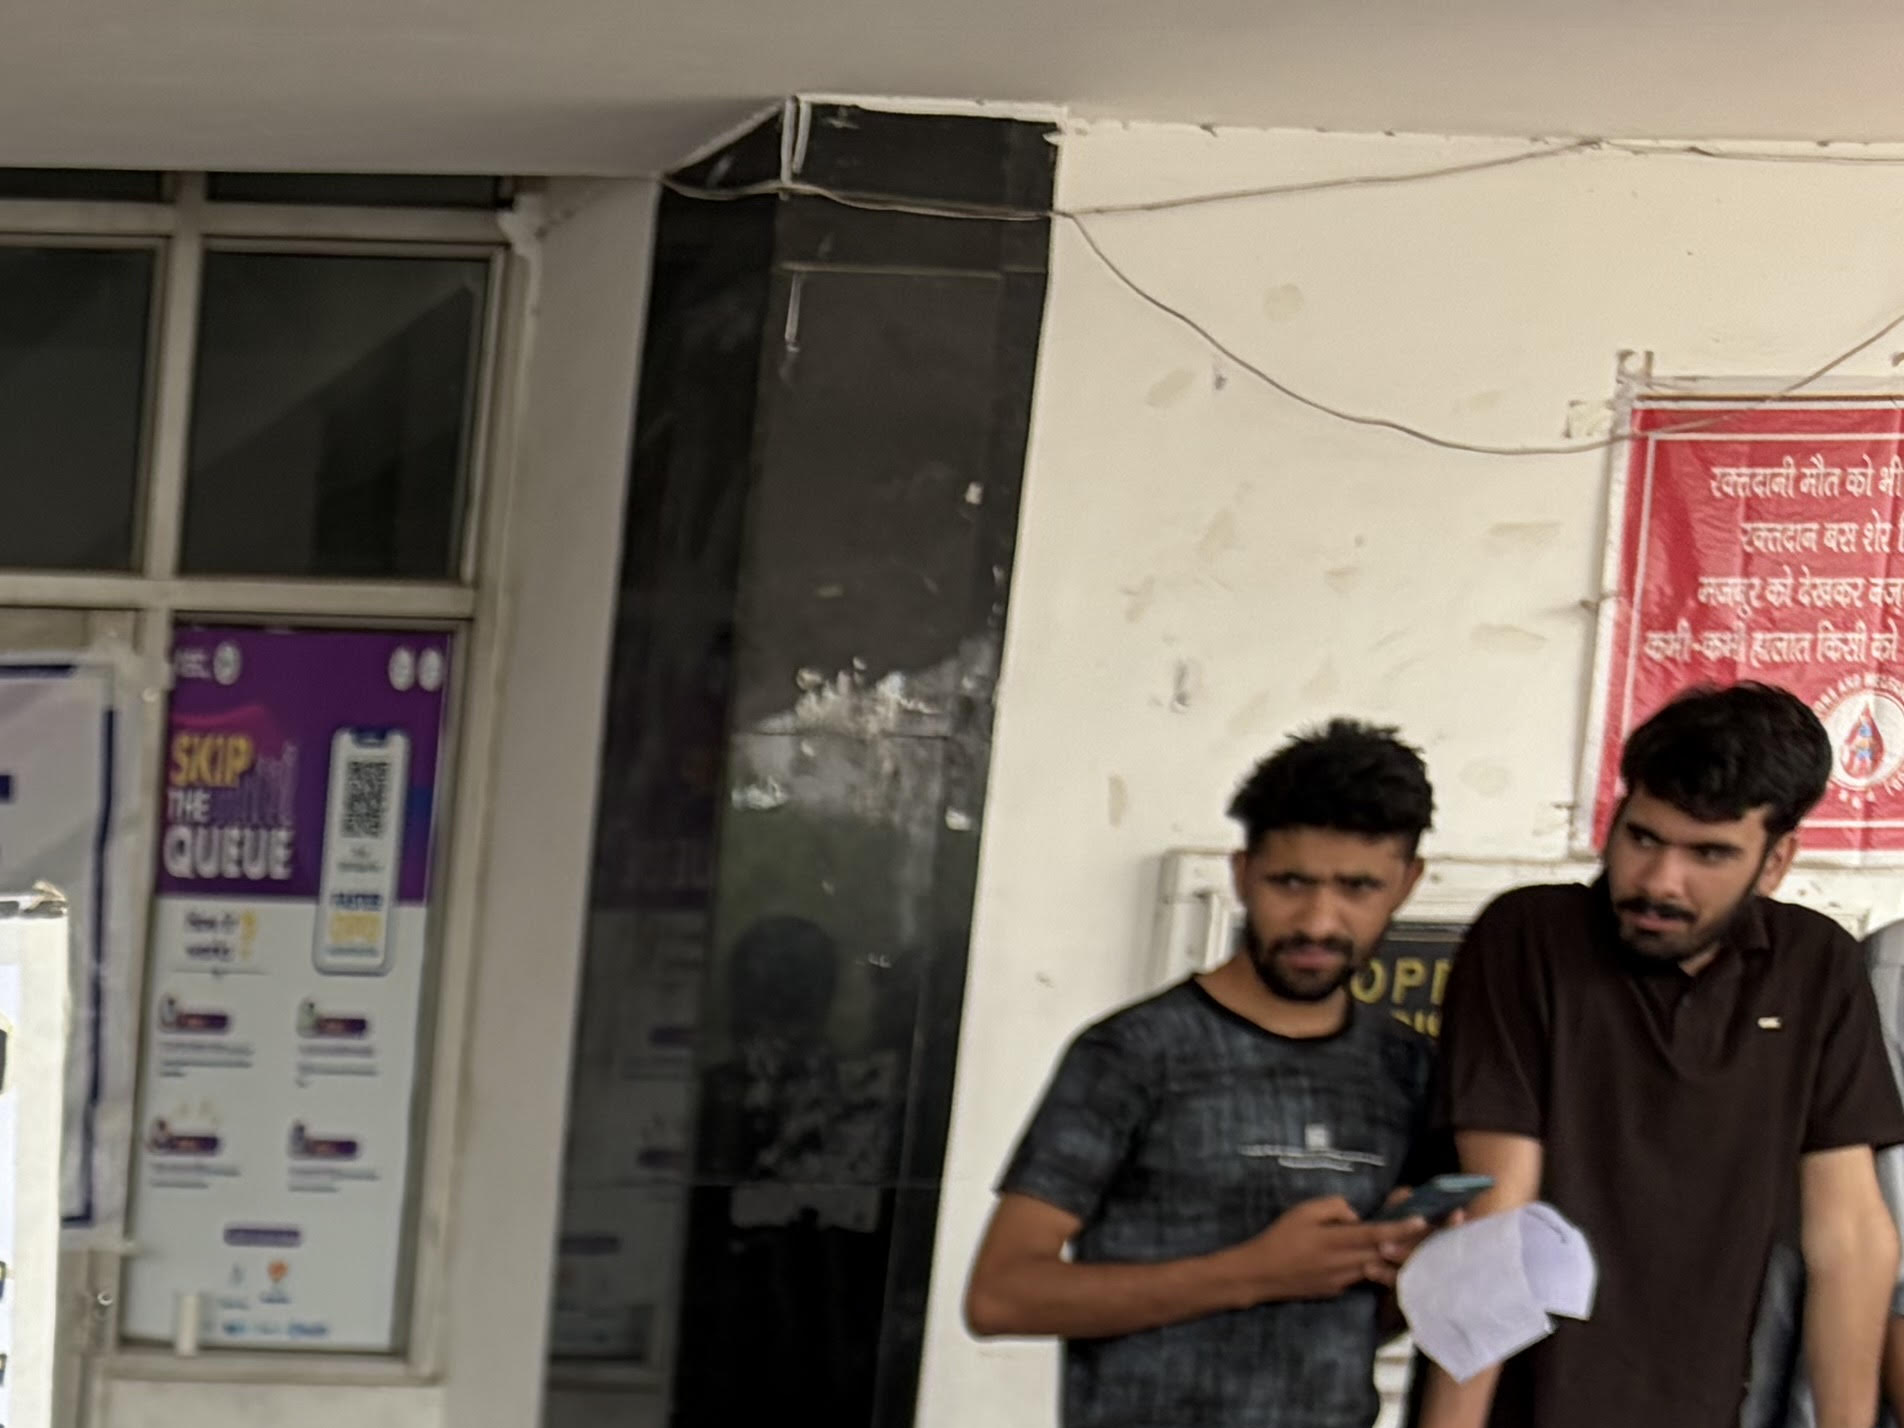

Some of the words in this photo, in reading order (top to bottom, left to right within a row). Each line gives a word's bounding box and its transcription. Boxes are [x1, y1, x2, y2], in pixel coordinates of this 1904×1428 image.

[1800, 453, 1843, 497] मौत
[1845, 454, 1874, 498] को
[169, 733, 256, 788] SKIP
[166, 790, 211, 823] THE
[162, 825, 294, 881] QUEUE
